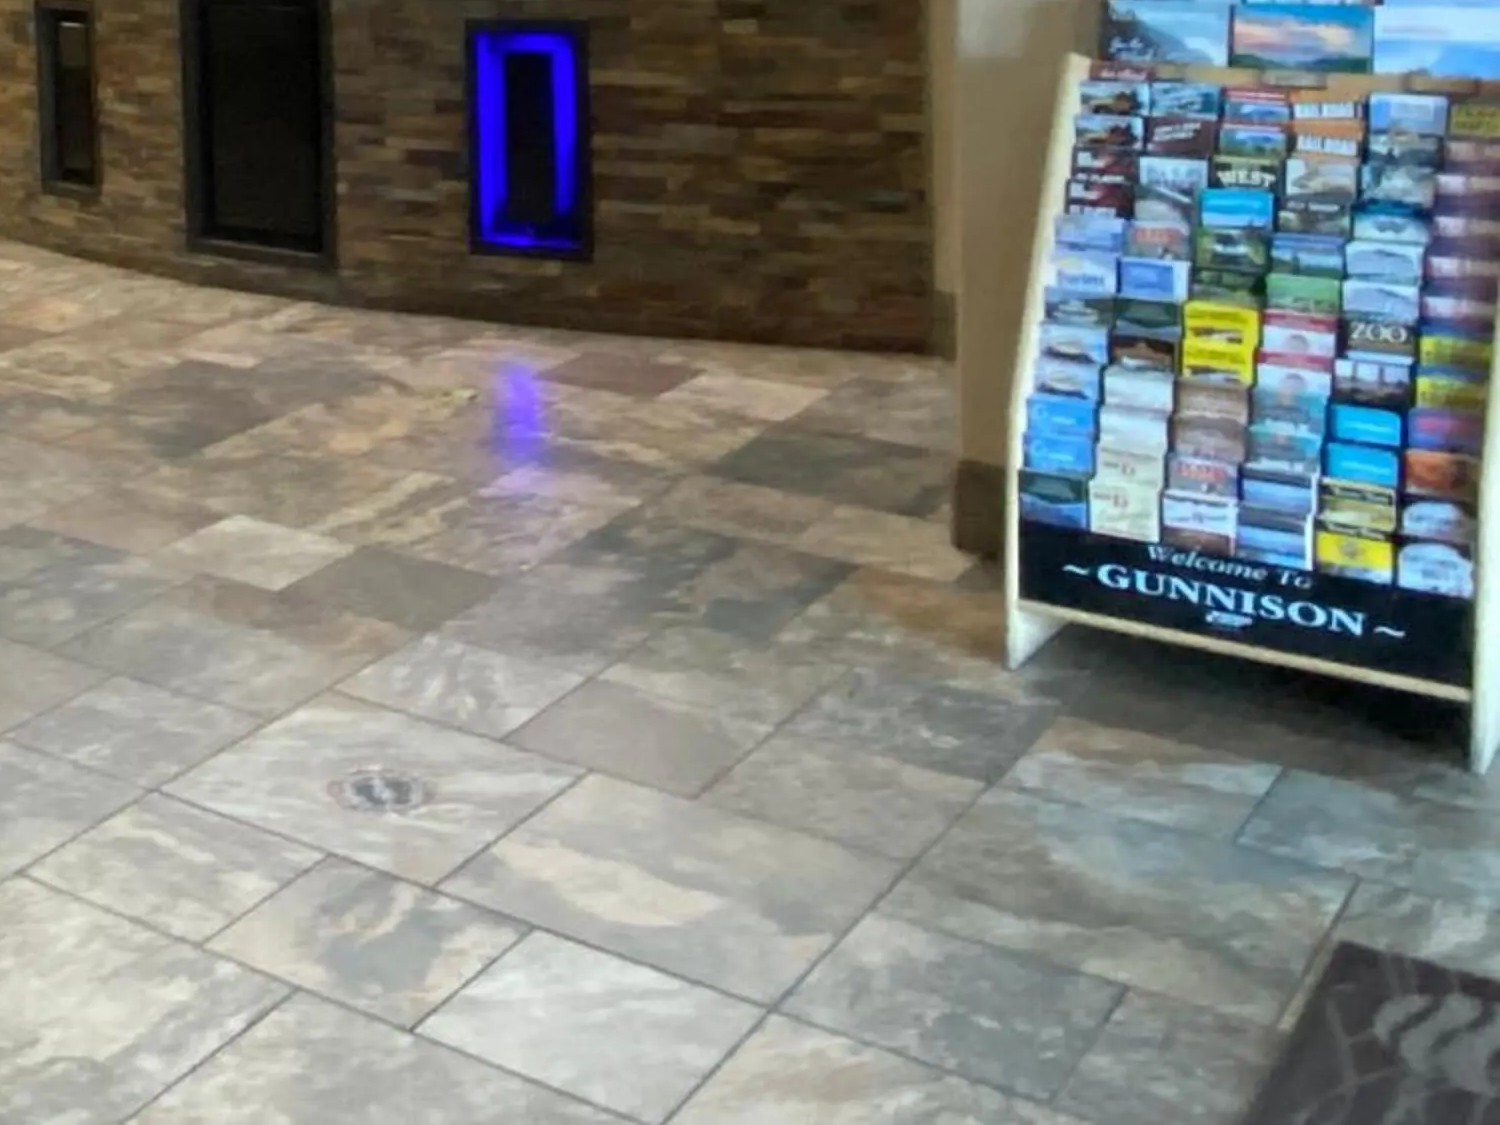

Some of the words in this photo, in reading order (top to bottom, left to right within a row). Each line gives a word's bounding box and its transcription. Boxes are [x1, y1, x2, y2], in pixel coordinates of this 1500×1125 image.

[1216, 169, 1277, 188] WEST
[1350, 321, 1408, 344] ZOO
[1147, 544, 1269, 582] Welcome
[1277, 568, 1313, 590] To
